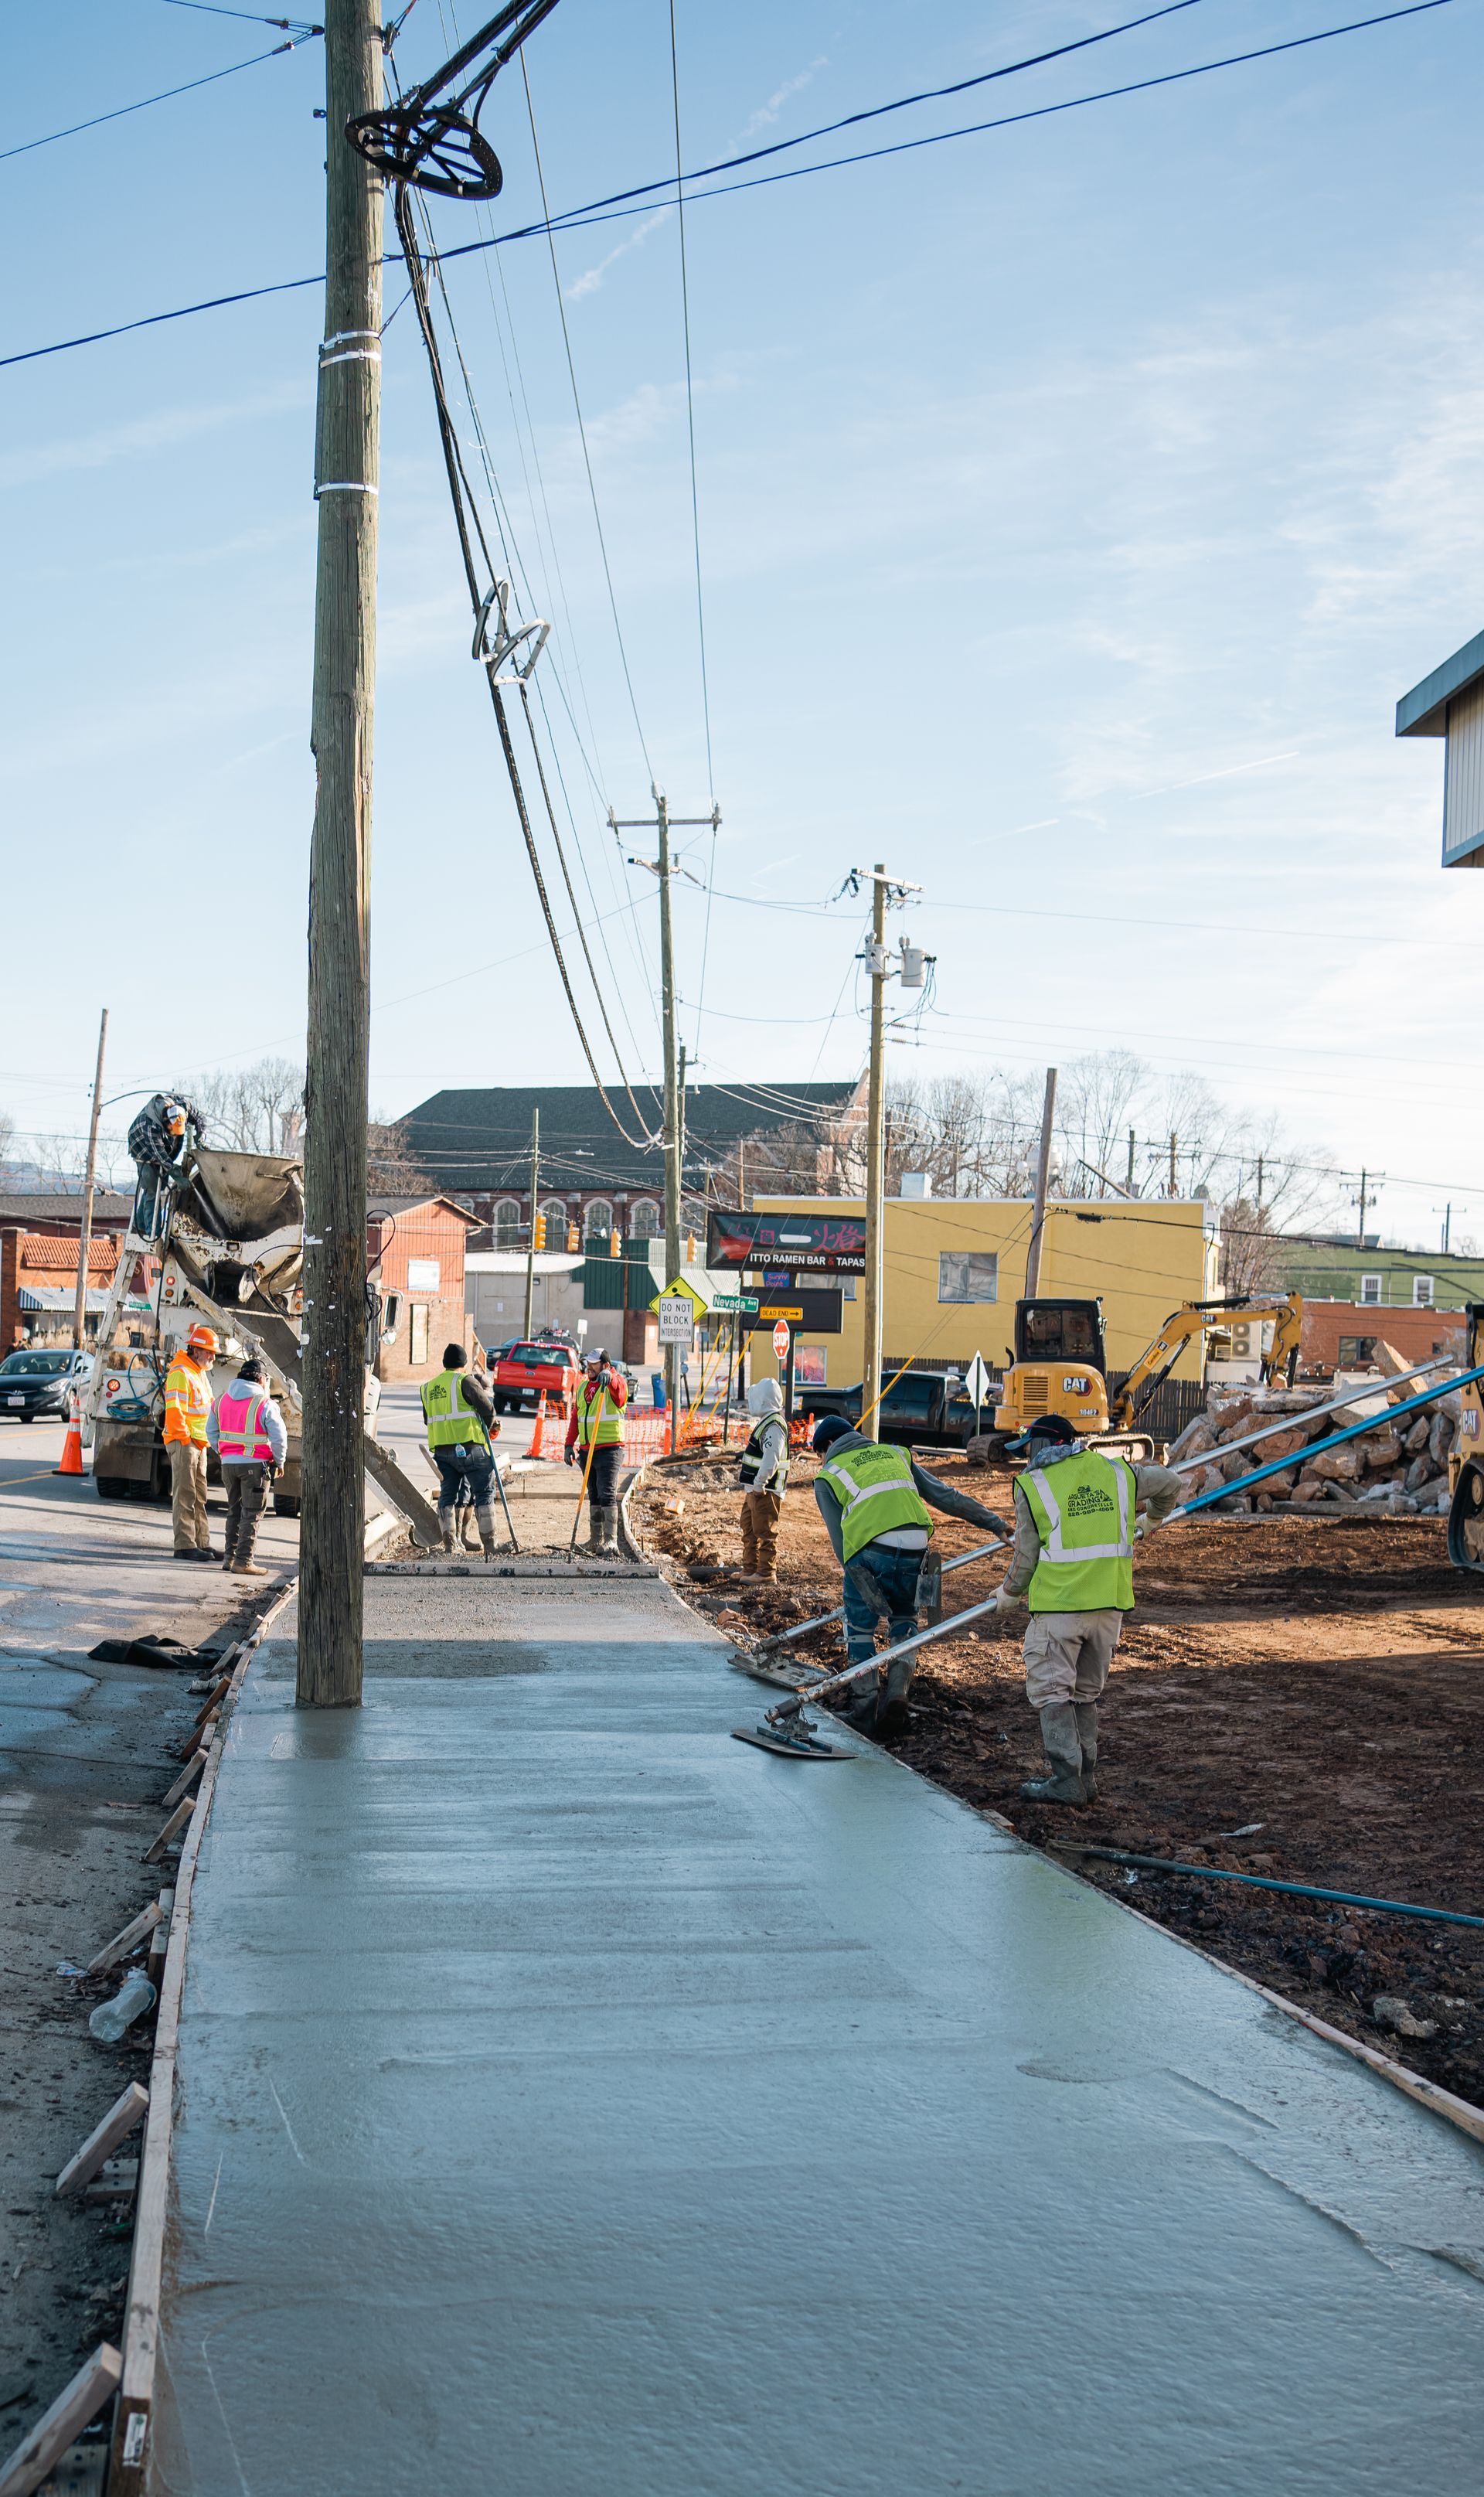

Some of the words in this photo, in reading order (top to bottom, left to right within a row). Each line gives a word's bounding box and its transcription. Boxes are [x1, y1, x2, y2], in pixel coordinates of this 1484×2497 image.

[750, 1253, 771, 1262] ITTO
[773, 1254, 805, 1264] RAMEN
[807, 1255, 825, 1265] BAR
[828, 1257, 835, 1266] &
[836, 1258, 865, 1267] TAPAS
[662, 1303, 672, 1312] DO
[714, 1296, 745, 1309] Nevada
[663, 1316, 689, 1324] BLOCK
[1201, 1314, 1214, 1323] CAT
[661, 1328, 691, 1337] INTERSECTION
[774, 1332, 788, 1347] STOP
[1063, 1377, 1087, 1392] CAT
[1462, 1409, 1477, 1435] CAT
[1068, 1490, 1100, 1500] ARGUETA'S
[1068, 1496, 1101, 1507] GRADING
